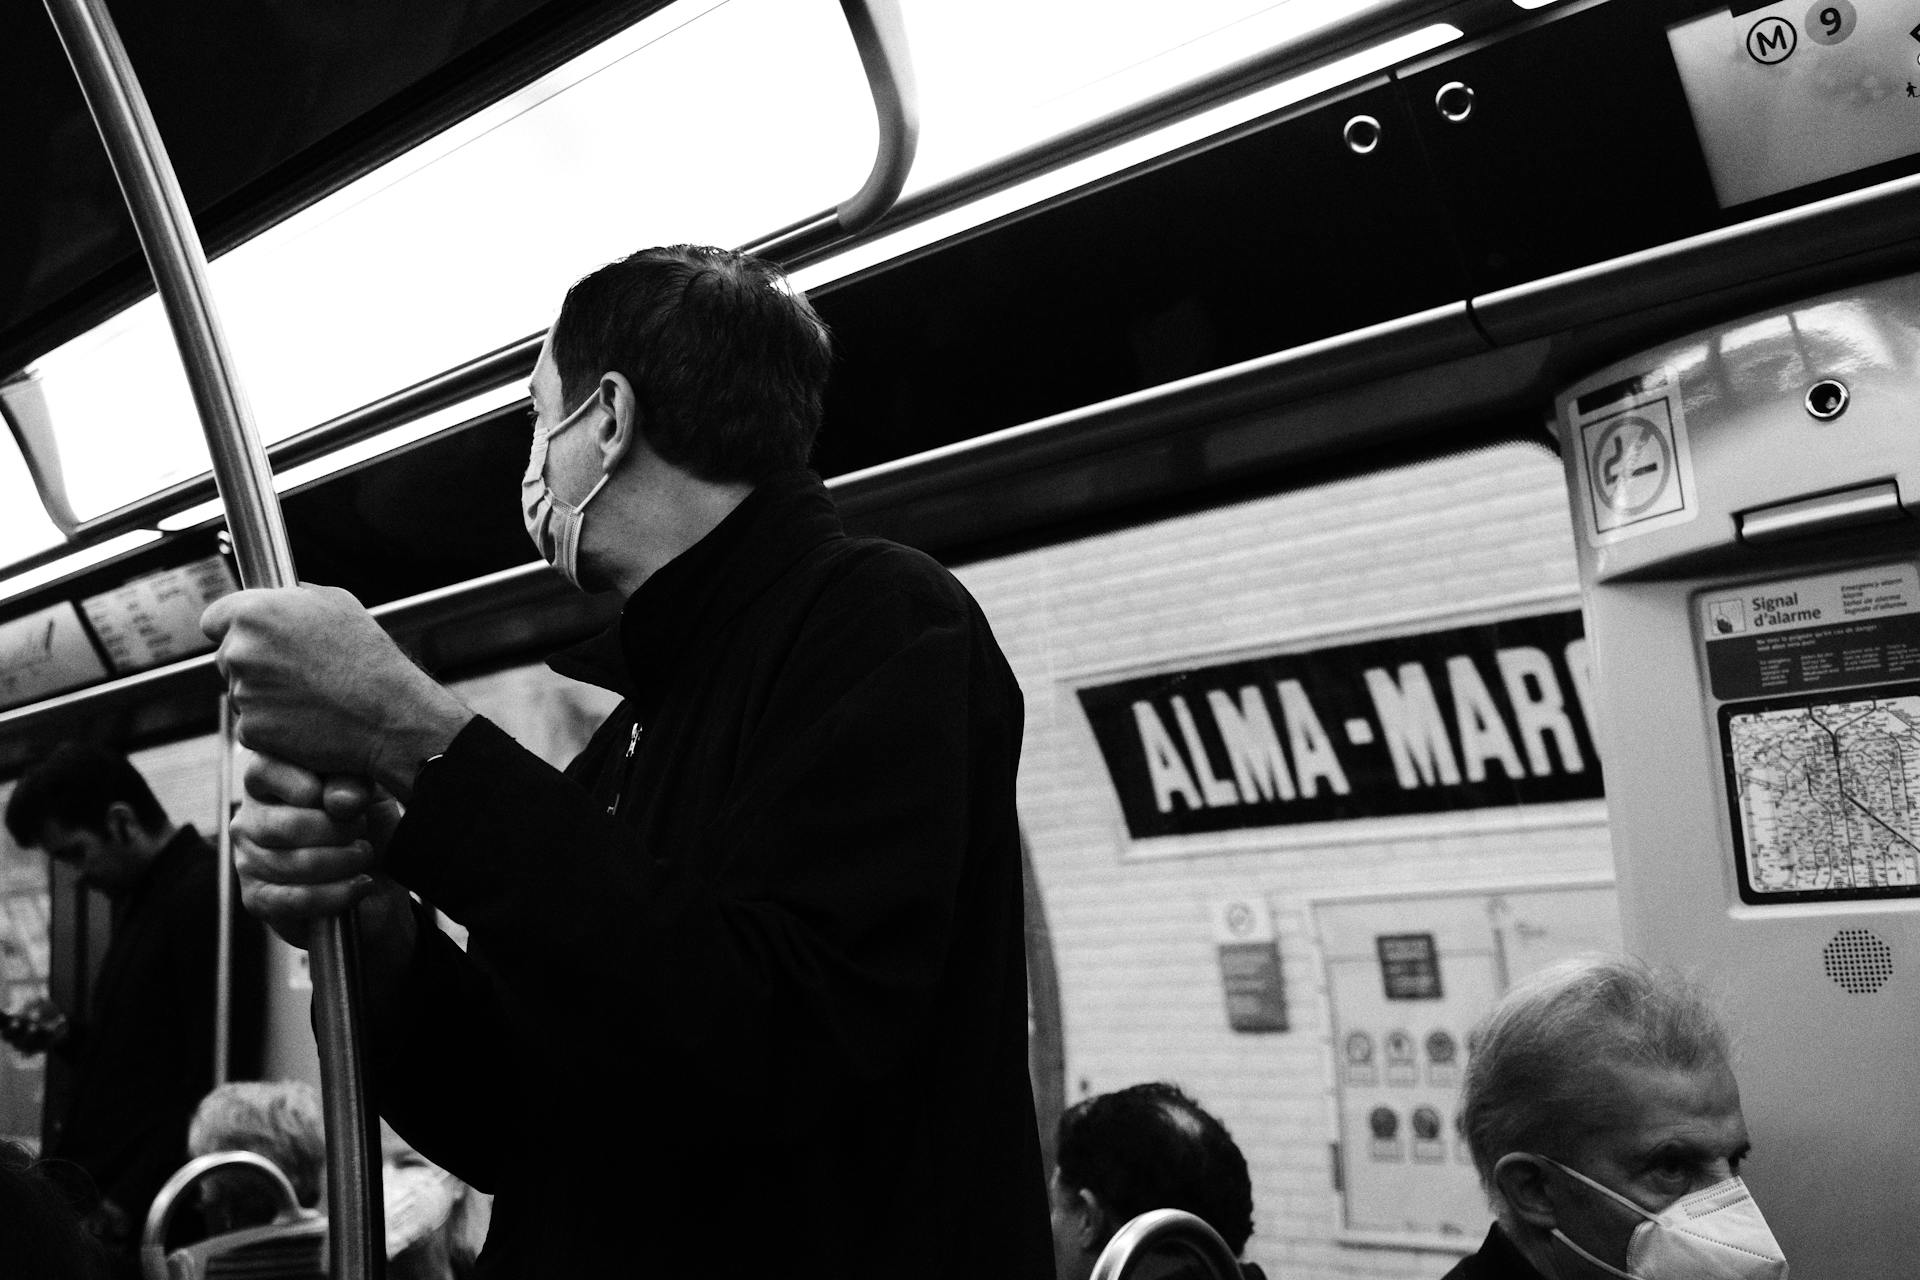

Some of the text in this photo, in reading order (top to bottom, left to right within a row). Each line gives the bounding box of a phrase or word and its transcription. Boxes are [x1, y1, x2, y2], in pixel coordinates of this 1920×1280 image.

[1756, 7, 1842, 56] M 9
[1752, 591, 1798, 612] Signal
[1754, 608, 1822, 627] d'alarme
